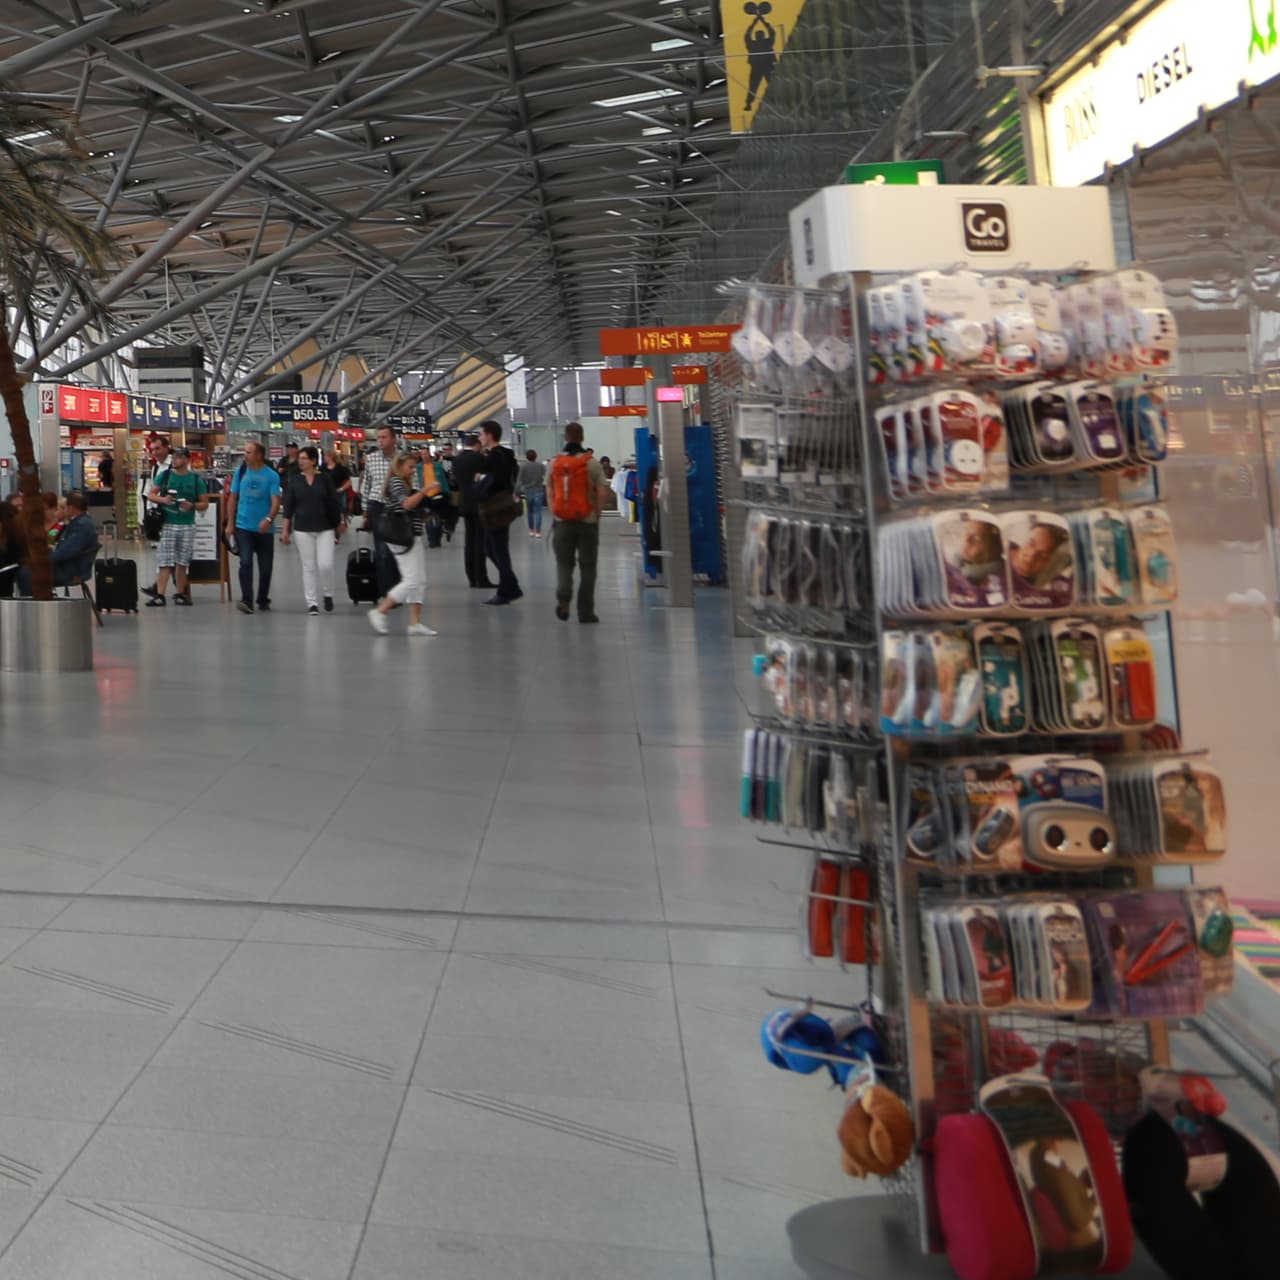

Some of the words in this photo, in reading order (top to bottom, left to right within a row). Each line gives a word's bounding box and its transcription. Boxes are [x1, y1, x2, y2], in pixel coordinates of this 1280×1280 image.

[1137, 42, 1193, 105] DIESEL
[966, 209, 1006, 237] Go
[292, 394, 330, 405] D10-41
